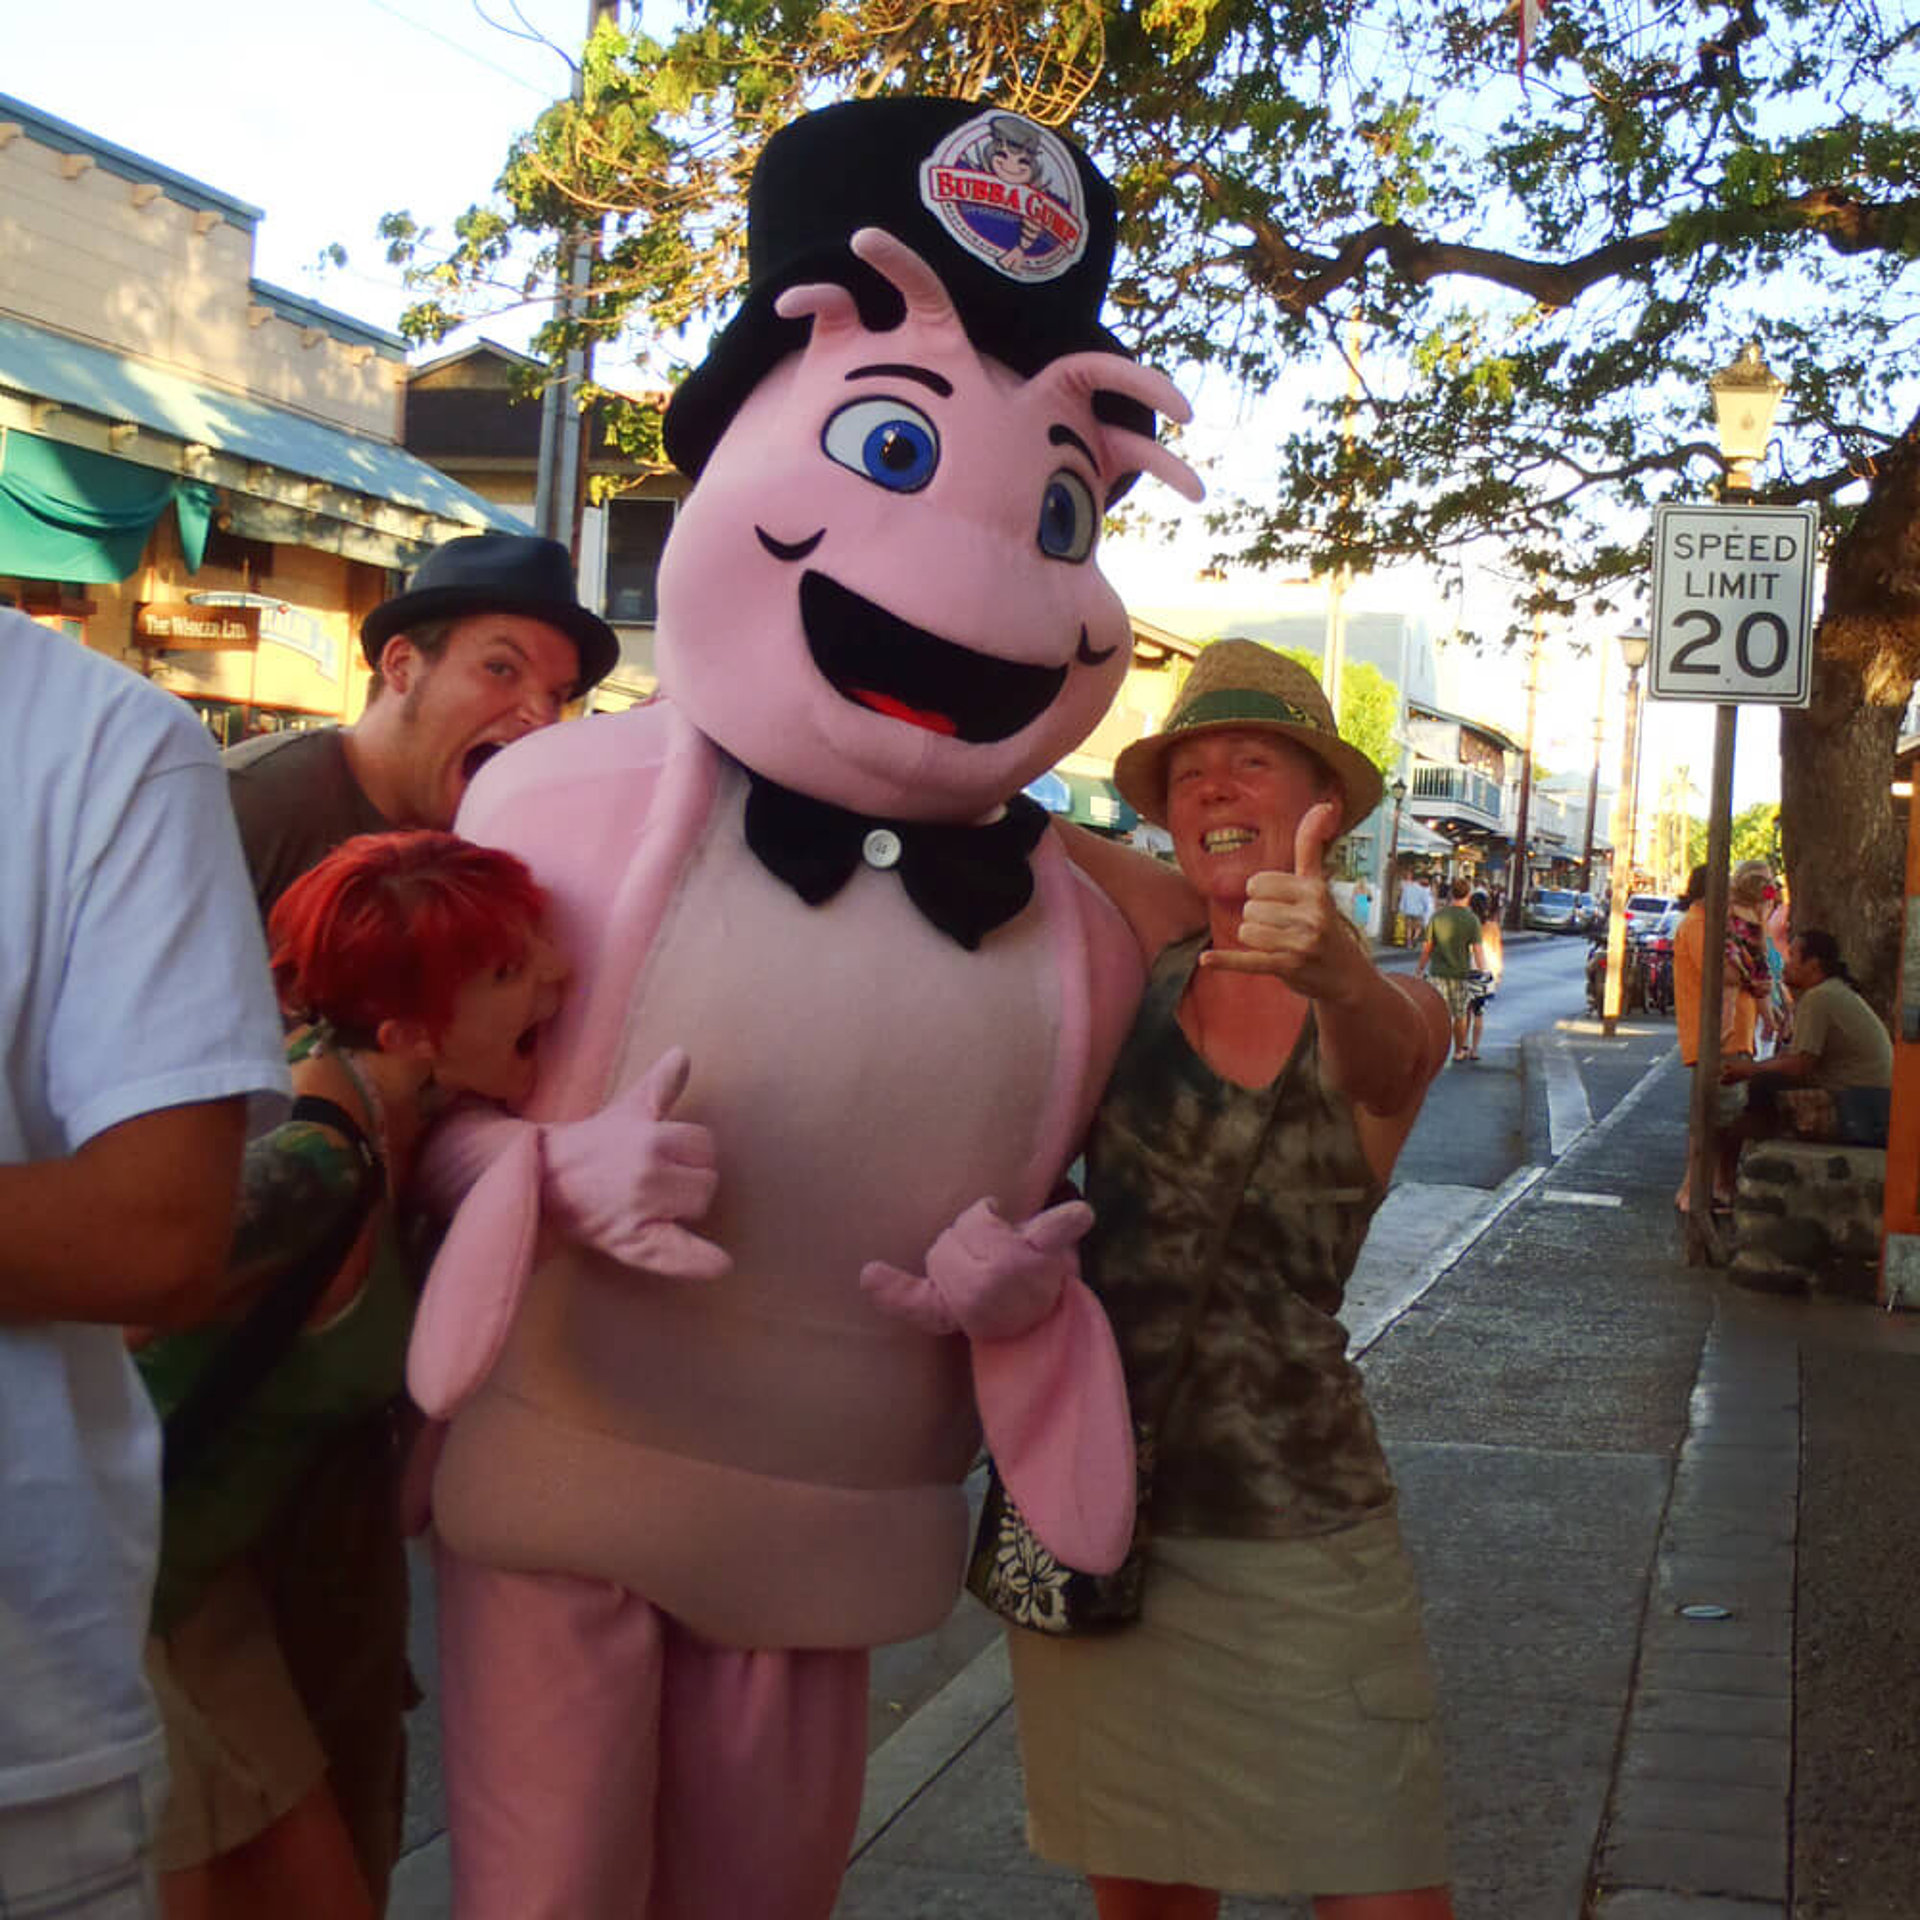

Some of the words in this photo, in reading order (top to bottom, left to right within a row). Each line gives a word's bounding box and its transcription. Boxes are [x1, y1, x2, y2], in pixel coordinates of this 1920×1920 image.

[937, 172, 1020, 209] BUBBA
[1673, 532, 1797, 562] SPEED
[1685, 570, 1780, 600] LIMIT
[1670, 610, 1790, 678] 20
